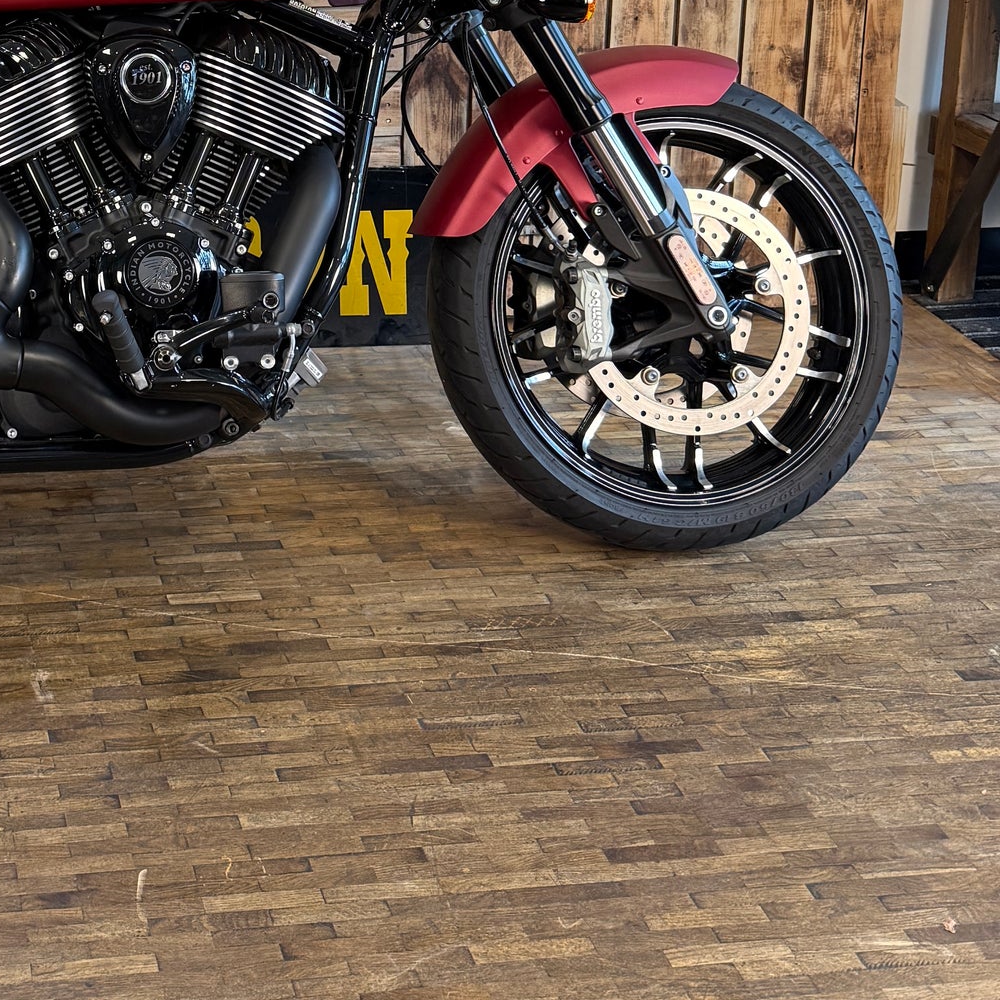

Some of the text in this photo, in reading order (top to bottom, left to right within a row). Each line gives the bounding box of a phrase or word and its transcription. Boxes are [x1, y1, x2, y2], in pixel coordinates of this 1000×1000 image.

[139, 63, 153, 72] est.
[131, 70, 164, 86] 1901
[130, 241, 192, 294] INDIAN MOTORCYCLE
[148, 296, 171, 305] 1901
[590, 289, 603, 344] brembo
